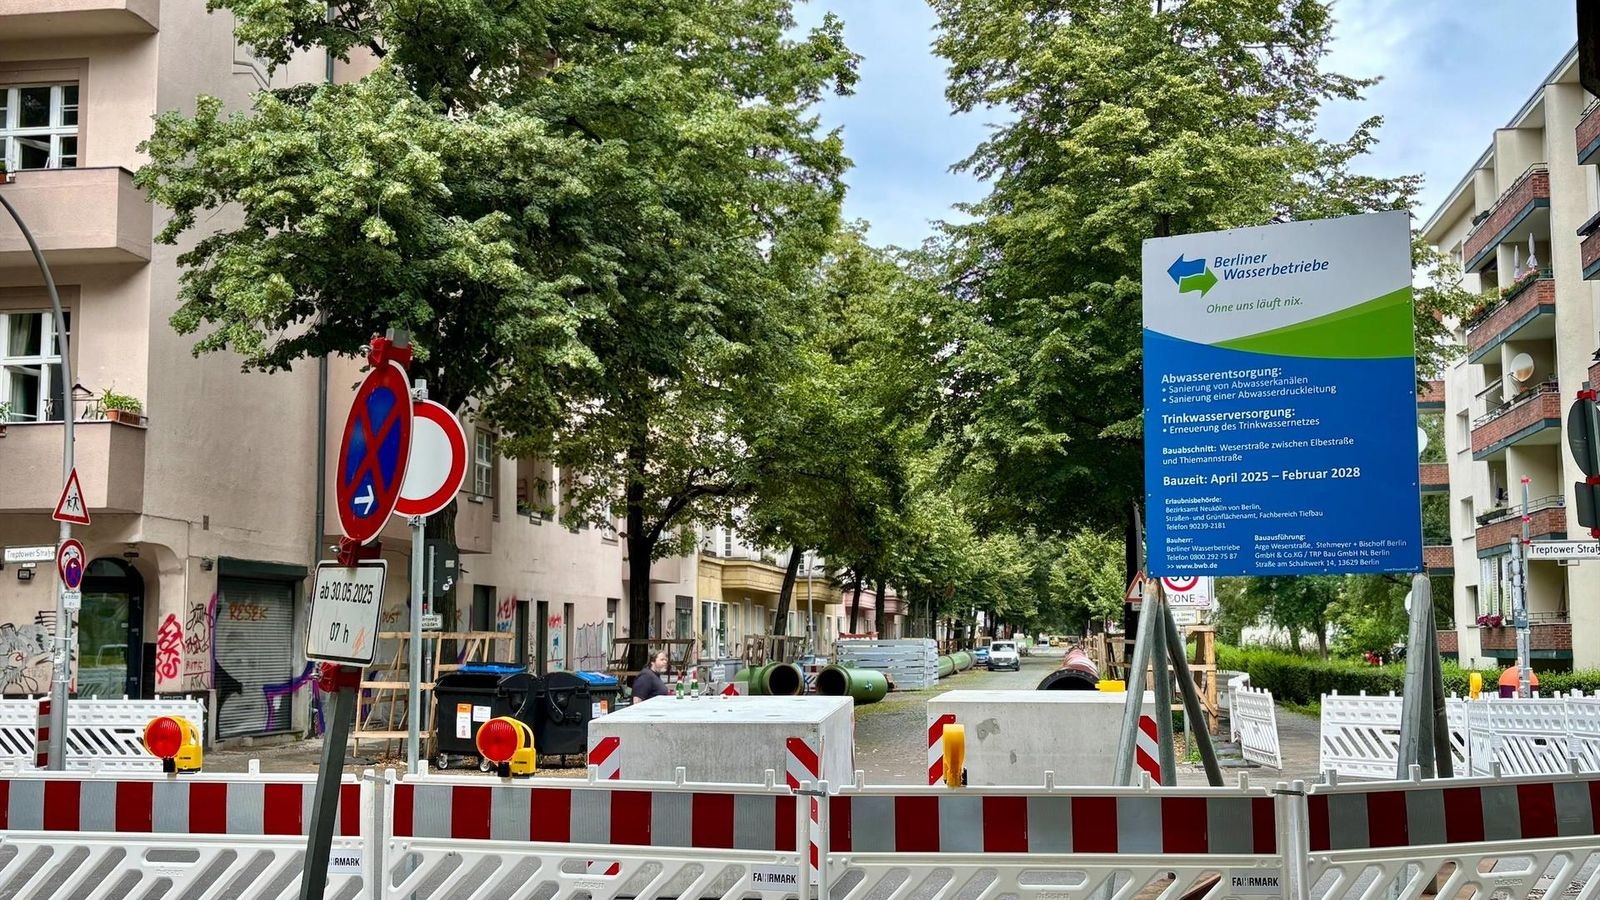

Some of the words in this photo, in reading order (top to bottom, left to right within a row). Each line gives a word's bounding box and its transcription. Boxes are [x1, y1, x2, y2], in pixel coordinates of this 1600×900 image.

[1214, 254, 1267, 268] Berliner
[1224, 260, 1329, 280] Wasserbetriebe
[1206, 303, 1236, 314] Ohne
[1239, 302, 1254, 310] uns
[1256, 298, 1281, 310] läuft
[1284, 297, 1303, 306] nix.
[1161, 367, 1282, 384] Abwasserentsorgung:
[1168, 384, 1212, 394] Sanierung
[1231, 376, 1308, 389] Abwasserkanälen
[1168, 394, 1212, 404] Sanierung
[1213, 392, 1236, 400] einer
[1238, 385, 1336, 399] Abwasserdruckleitung
[1161, 408, 1295, 424] Trinkwasserversorgung:
[1169, 424, 1220, 434] Erneuerung
[1221, 422, 1236, 431] des
[1238, 418, 1320, 430] Trinkwassernetzes
[1162, 445, 1216, 455] Bauabschnitt:
[1219, 441, 1270, 452] Weserstraße
[1272, 440, 1308, 449] zwischen
[1310, 436, 1354, 447] Elbestraße
[1162, 457, 1178, 465] und
[1179, 454, 1242, 464] Thiemannstraße
[1163, 474, 1208, 486] Bauzeit:
[1210, 472, 1238, 486] April
[1240, 472, 1268, 482] 2025
[1282, 468, 1328, 480] Februar
[1331, 467, 1361, 478] 2028
[1166, 506, 1199, 514] Bezirksamt
[1200, 504, 1227, 512] Neukölln
[1206, 512, 1258, 520] Grünflächenamt,
[1299, 510, 1324, 518] Tiefbau
[1188, 522, 1226, 530] 90239-2181
[1254, 534, 1306, 542] Bauausführung:
[1191, 544, 1240, 552] Wasserbetriebe
[1270, 542, 1314, 550] Weserstraße,
[1358, 540, 1386, 548] Bischoff
[1386, 539, 1407, 547] Berlin
[1530, 544, 1574, 556] Treptower
[7, 550, 35, 558] Treptower
[1309, 550, 1322, 558] TRP
[1323, 550, 1336, 558] Bau
[1176, 562, 1218, 570] www.bwb.de
[1255, 560, 1276, 568] Straße
[1289, 560, 1325, 568] Schaltwerk
[1338, 558, 1358, 566] 13629
[1360, 558, 1380, 566] Berlin
[320, 581, 330, 600] ab
[330, 582, 374, 604] 30.05.2025
[1173, 594, 1196, 603] ONE
[330, 622, 340, 642] 07
[342, 624, 349, 644] h
